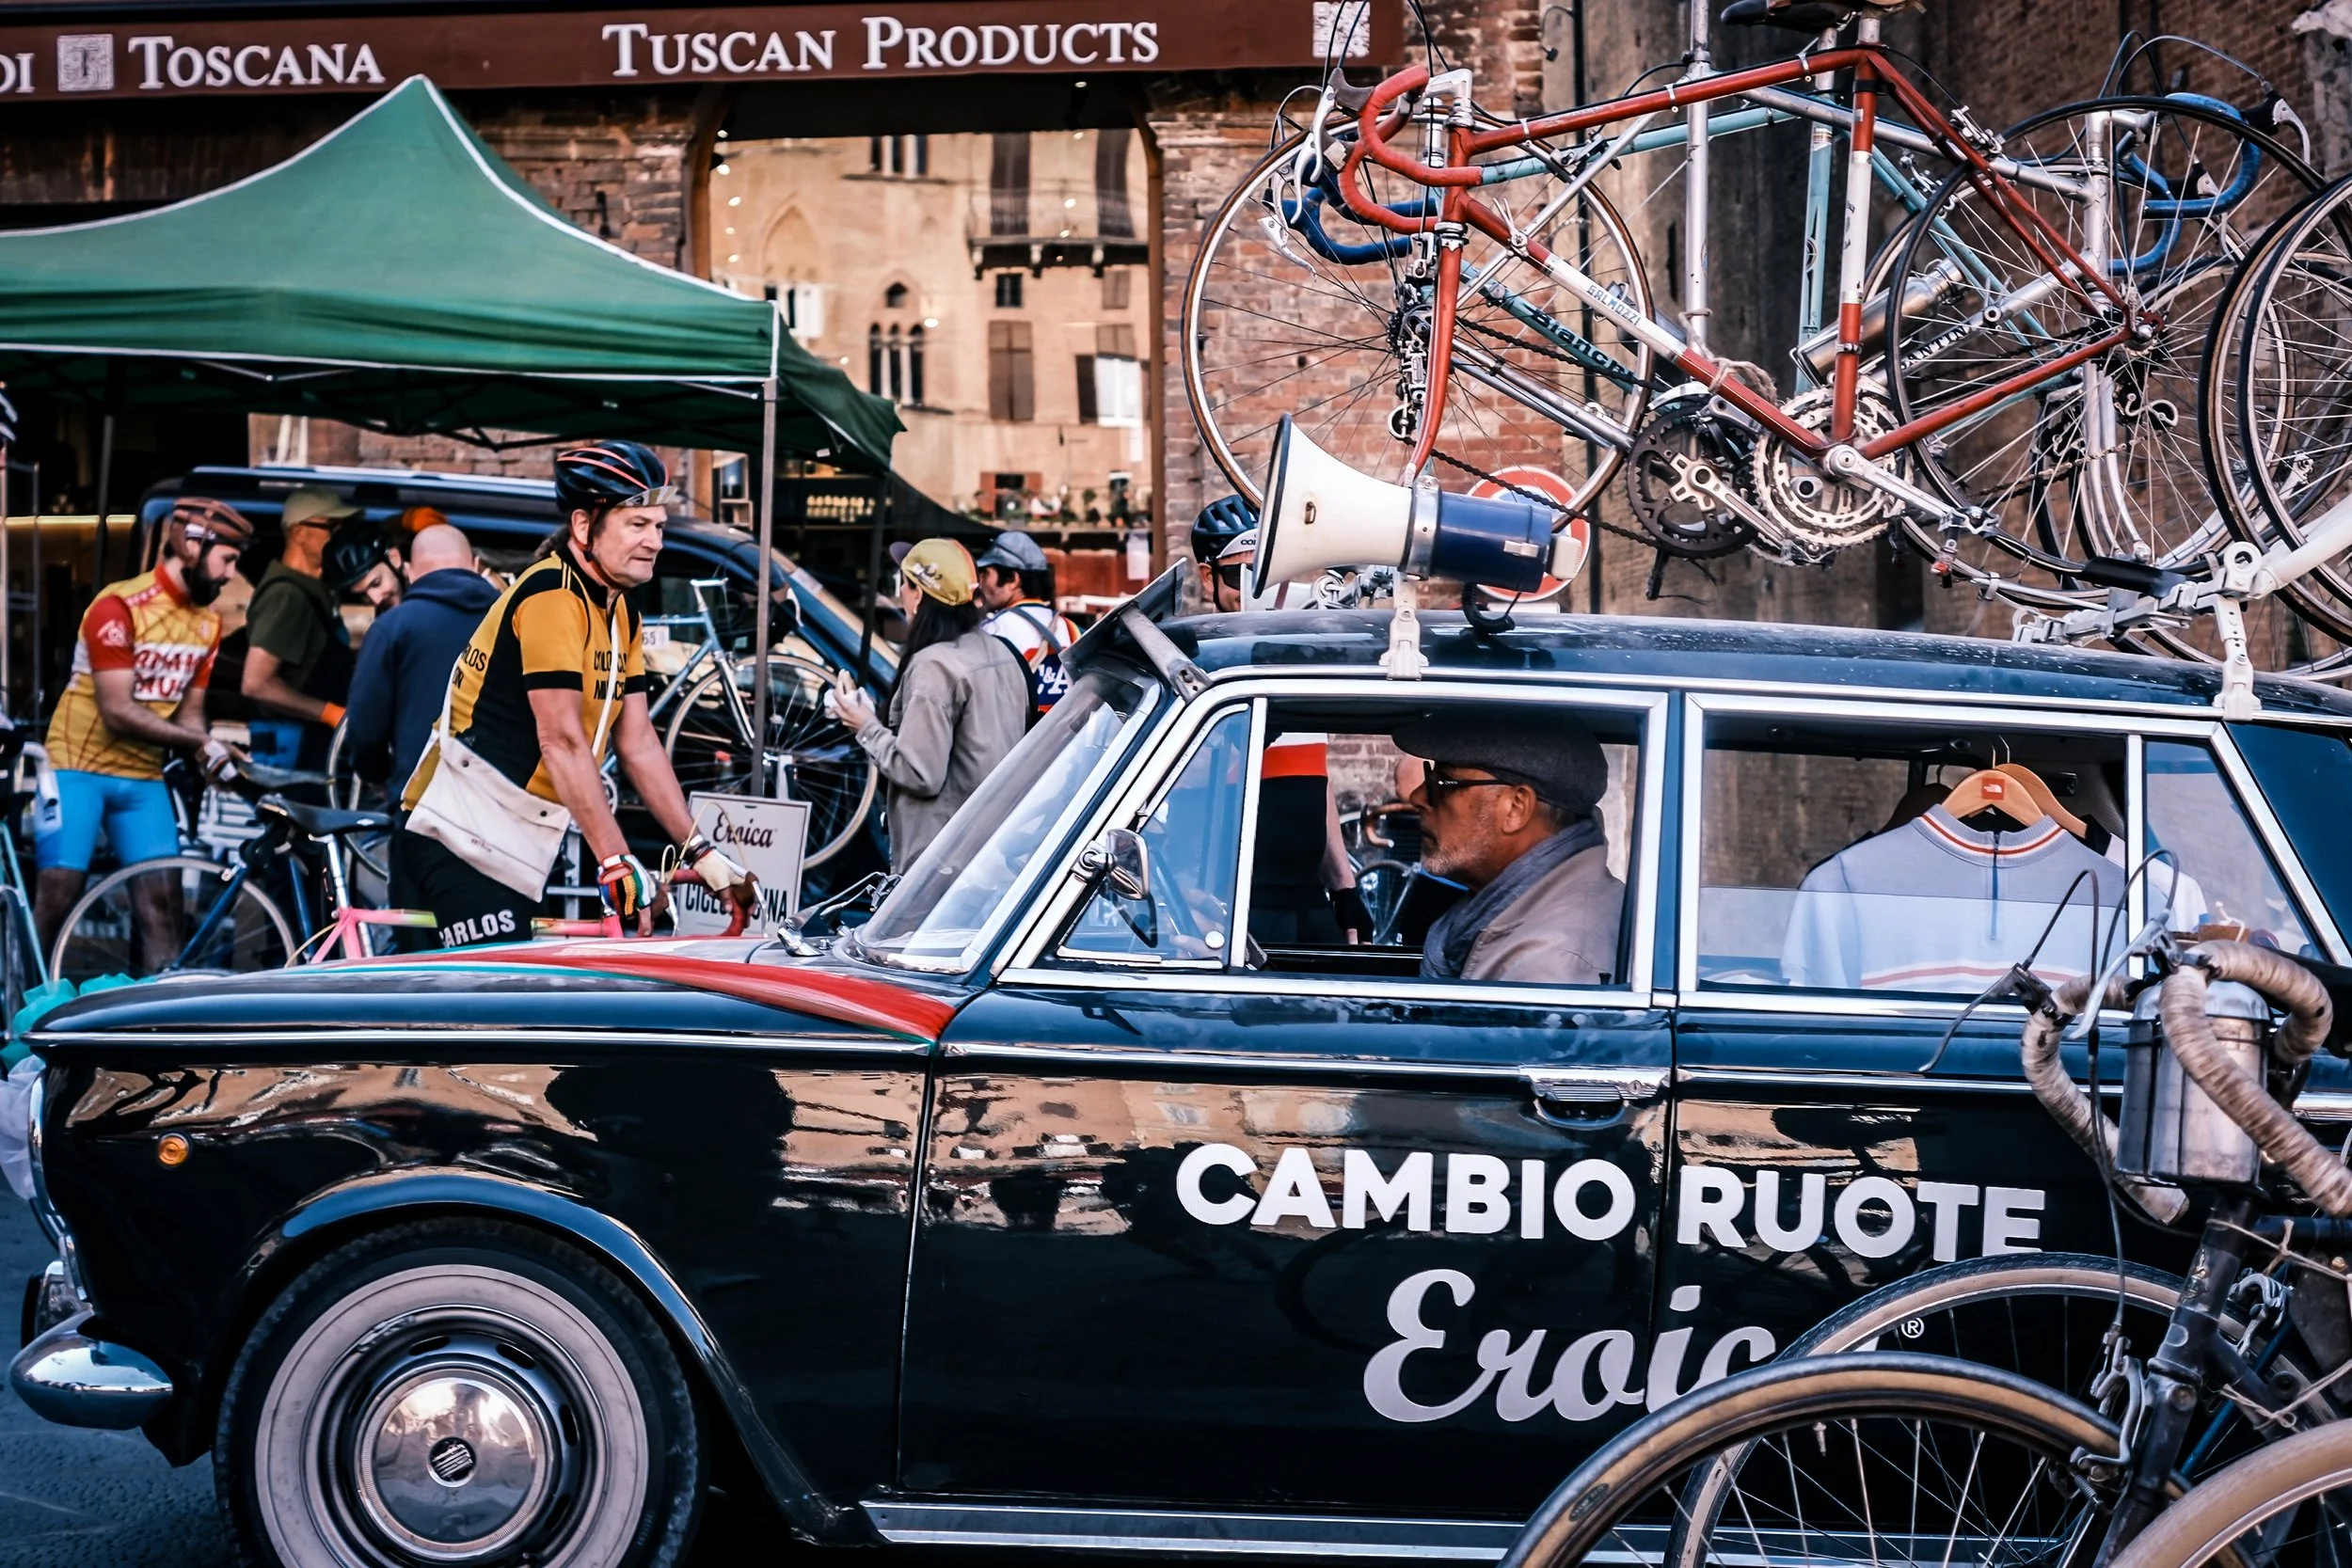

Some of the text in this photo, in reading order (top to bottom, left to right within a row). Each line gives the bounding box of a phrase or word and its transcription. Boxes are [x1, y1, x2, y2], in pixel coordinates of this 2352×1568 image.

[128, 35, 386, 89] TOSCANA
[601, 16, 1160, 77] TUSCAN PRODUCTS
[1176, 1143, 2045, 1263] CAMBIO RUOTE
[1363, 1269, 1778, 1423] Eroic
